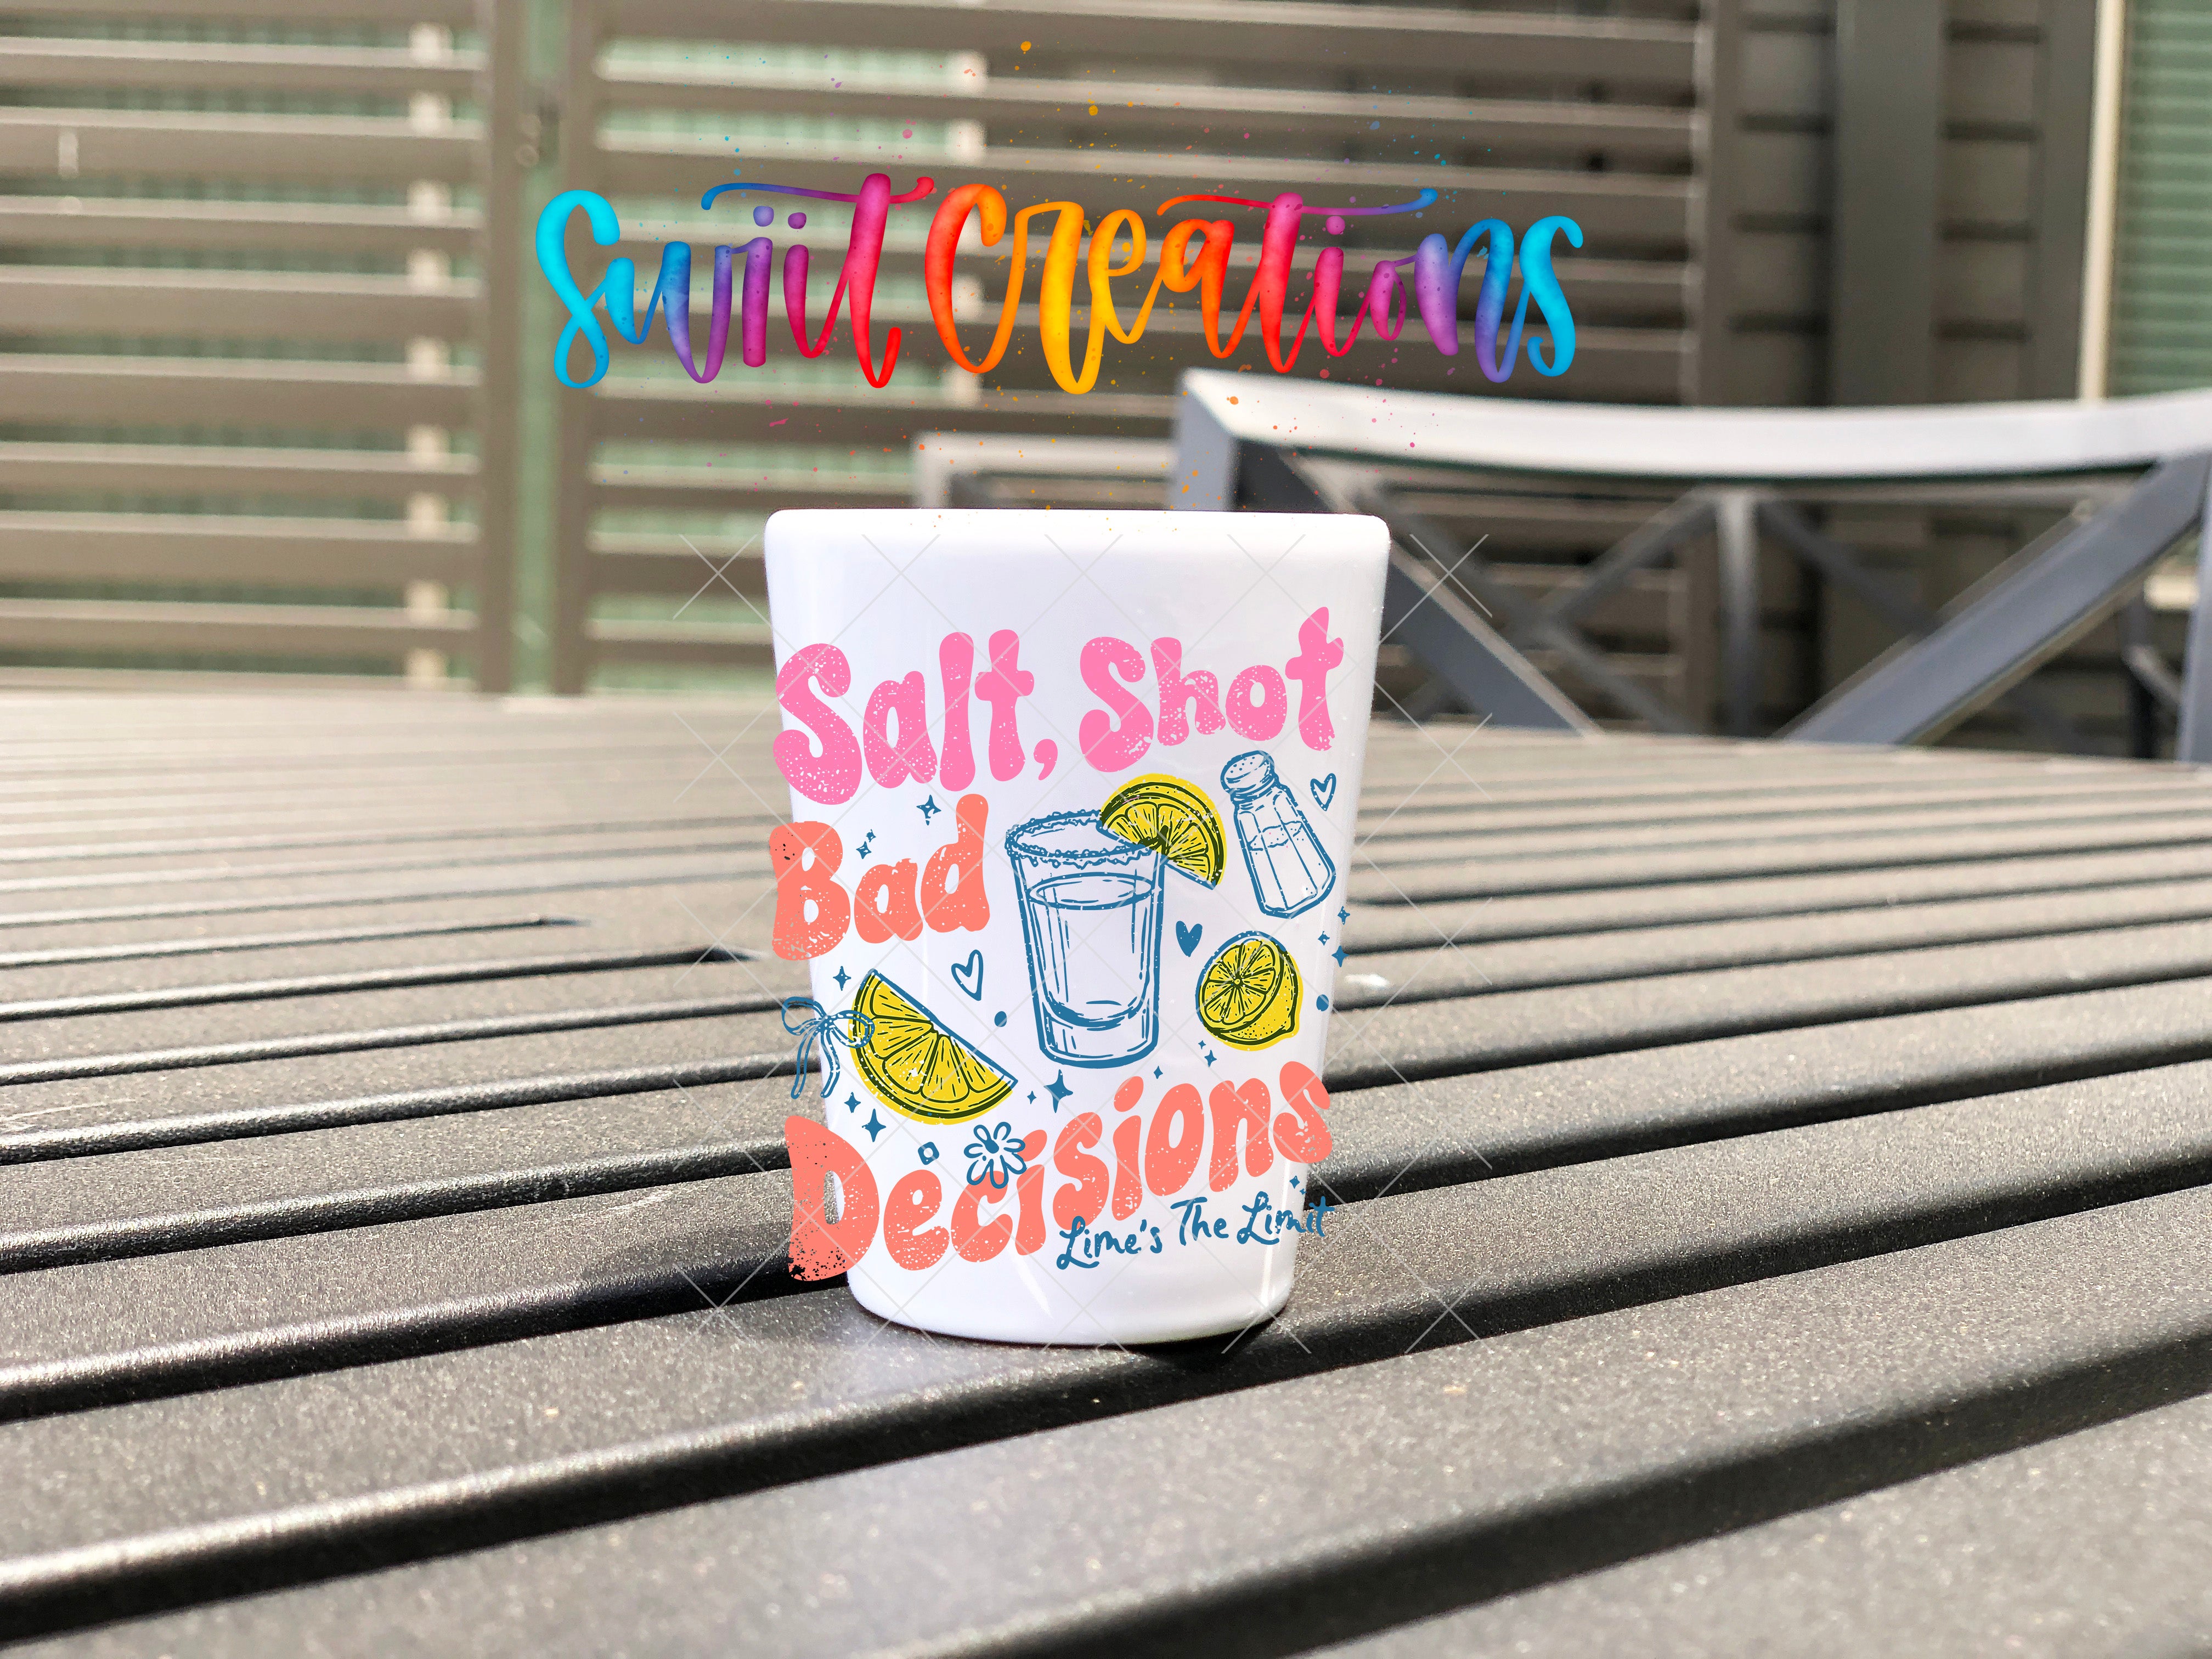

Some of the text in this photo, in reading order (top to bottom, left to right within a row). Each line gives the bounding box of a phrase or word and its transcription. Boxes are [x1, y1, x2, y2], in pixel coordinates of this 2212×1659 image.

[772, 606, 1344, 805] Salt, Shot
[769, 793, 991, 961] Bad
[785, 1061, 1334, 1282] Decisions
[1056, 1190, 1335, 1270] Lime's The Limit
